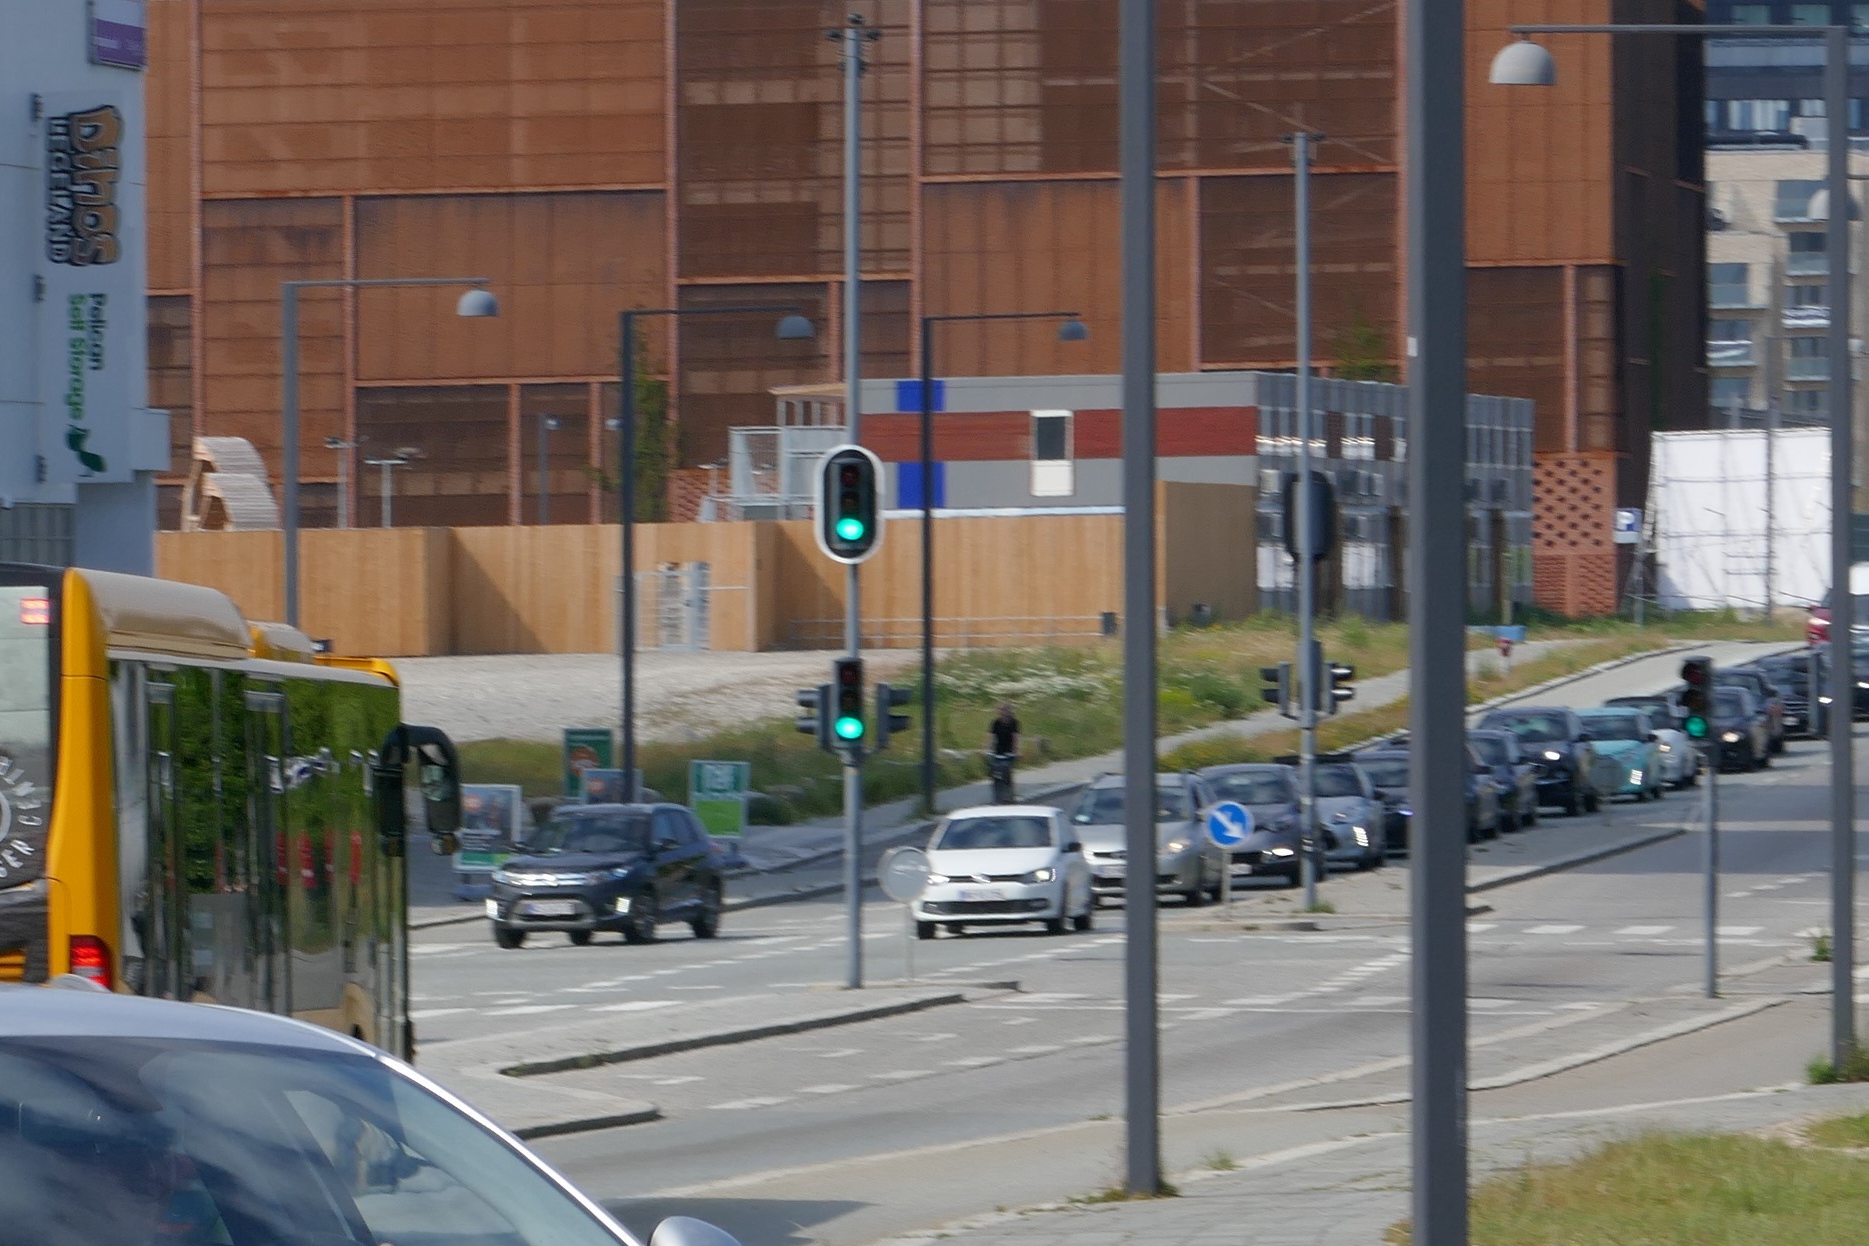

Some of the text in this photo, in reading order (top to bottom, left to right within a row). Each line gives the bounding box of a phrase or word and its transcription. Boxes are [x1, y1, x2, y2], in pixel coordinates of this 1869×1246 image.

[67, 104, 123, 267] Dinos
[65, 294, 87, 421] Self Storage
[88, 293, 108, 370] Pelican
[1617, 511, 1635, 531] P
